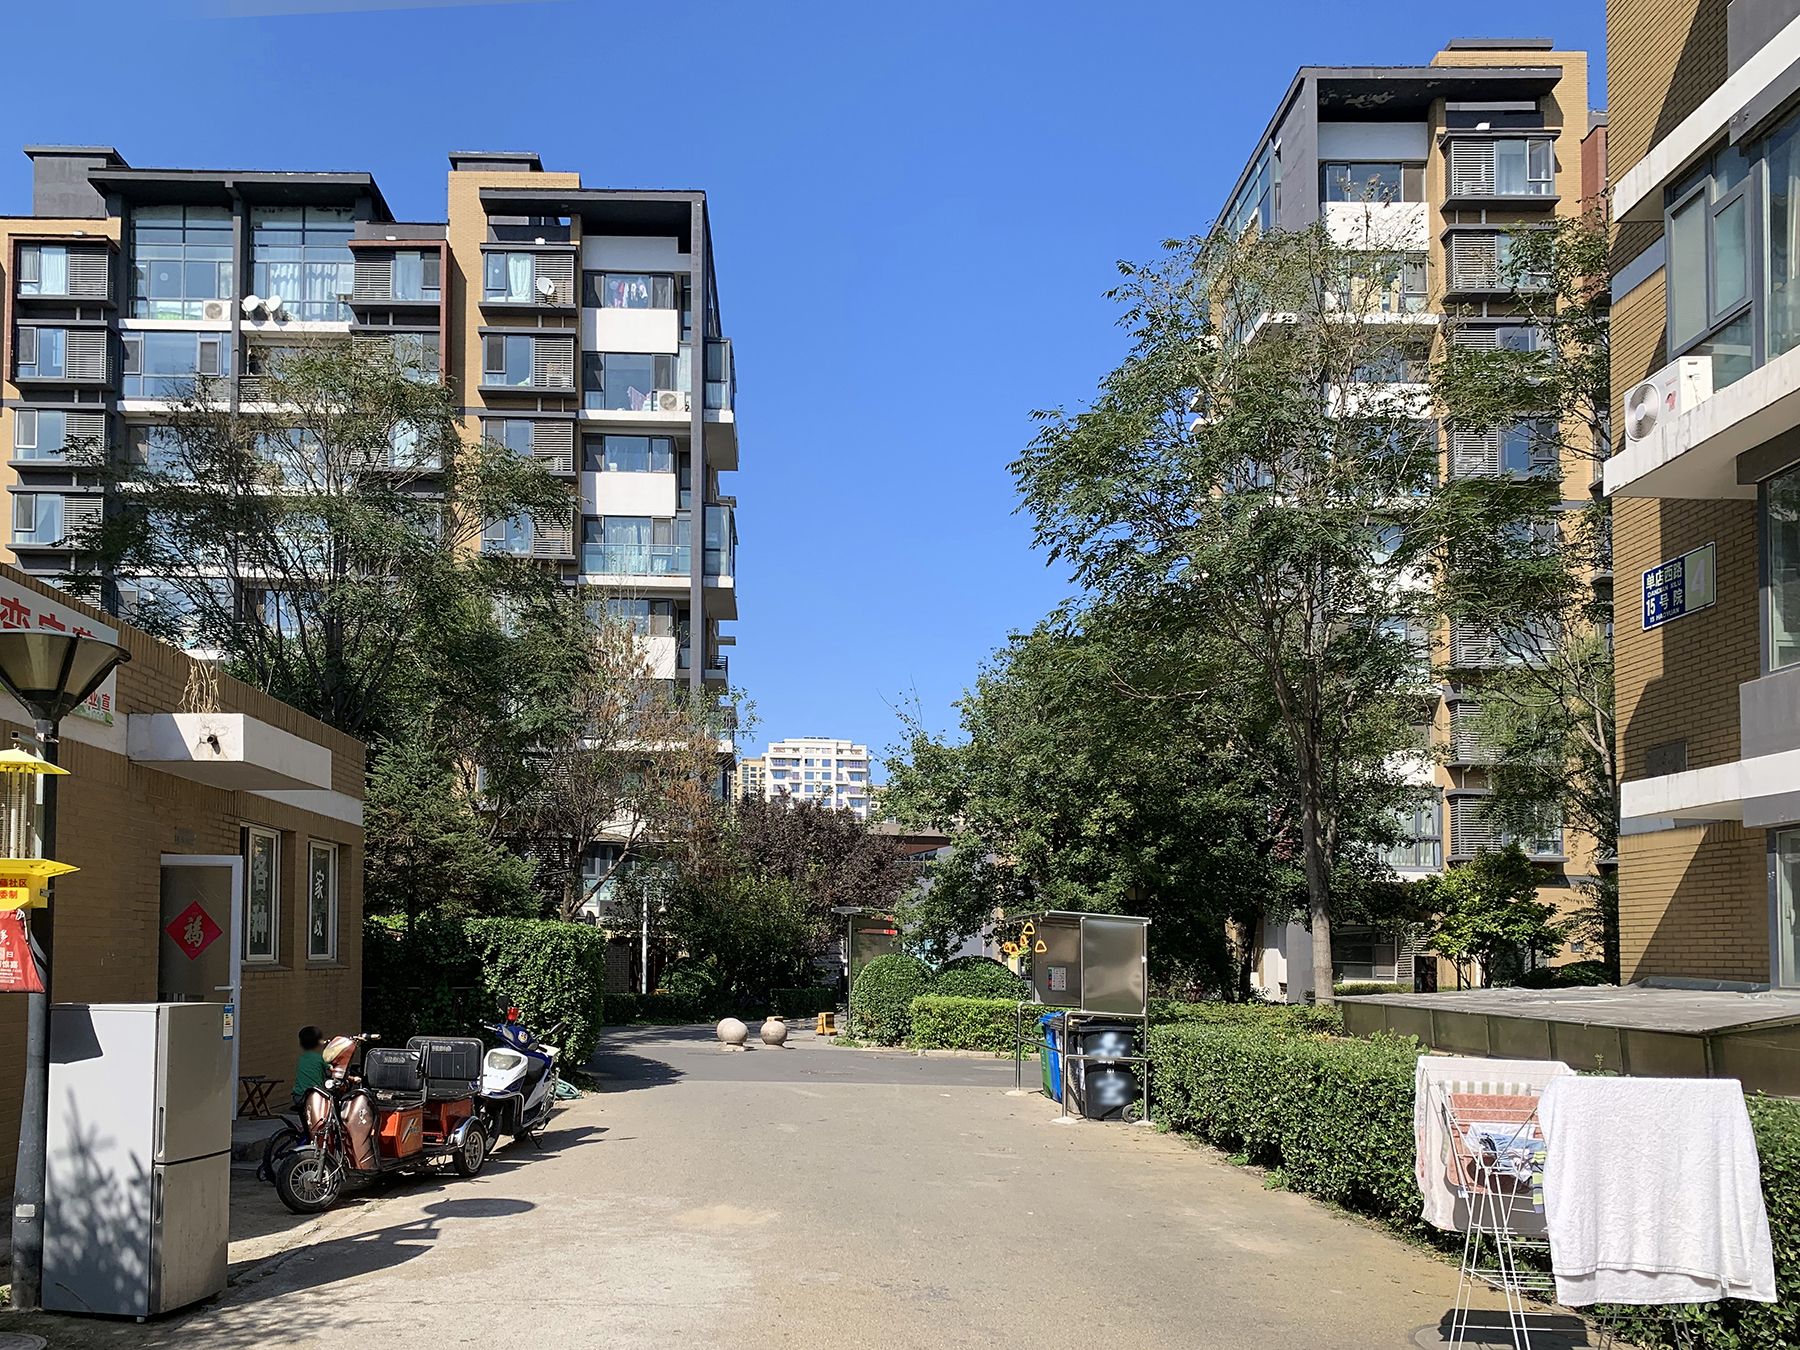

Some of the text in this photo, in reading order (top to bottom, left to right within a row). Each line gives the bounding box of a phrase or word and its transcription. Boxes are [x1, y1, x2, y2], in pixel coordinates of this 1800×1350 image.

[1646, 562, 1682, 590] 单店西路
[1691, 559, 1705, 593] 4
[184, 914, 204, 948] 福
